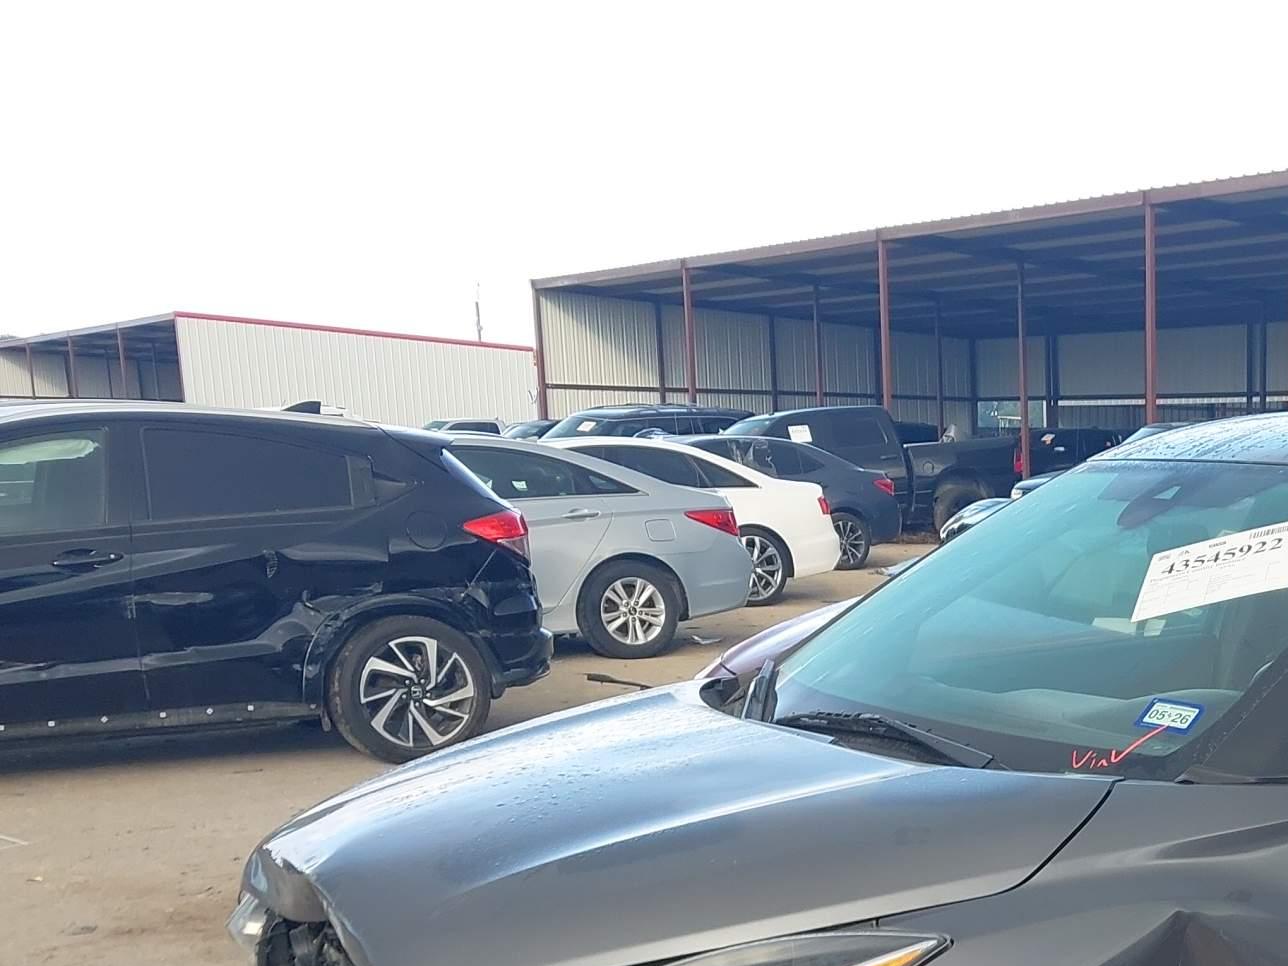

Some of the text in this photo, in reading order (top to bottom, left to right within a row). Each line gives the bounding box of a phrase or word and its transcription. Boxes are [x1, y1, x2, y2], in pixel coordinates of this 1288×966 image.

[1160, 537, 1284, 575] 43545922
[1148, 709, 1191, 725] 05 26
